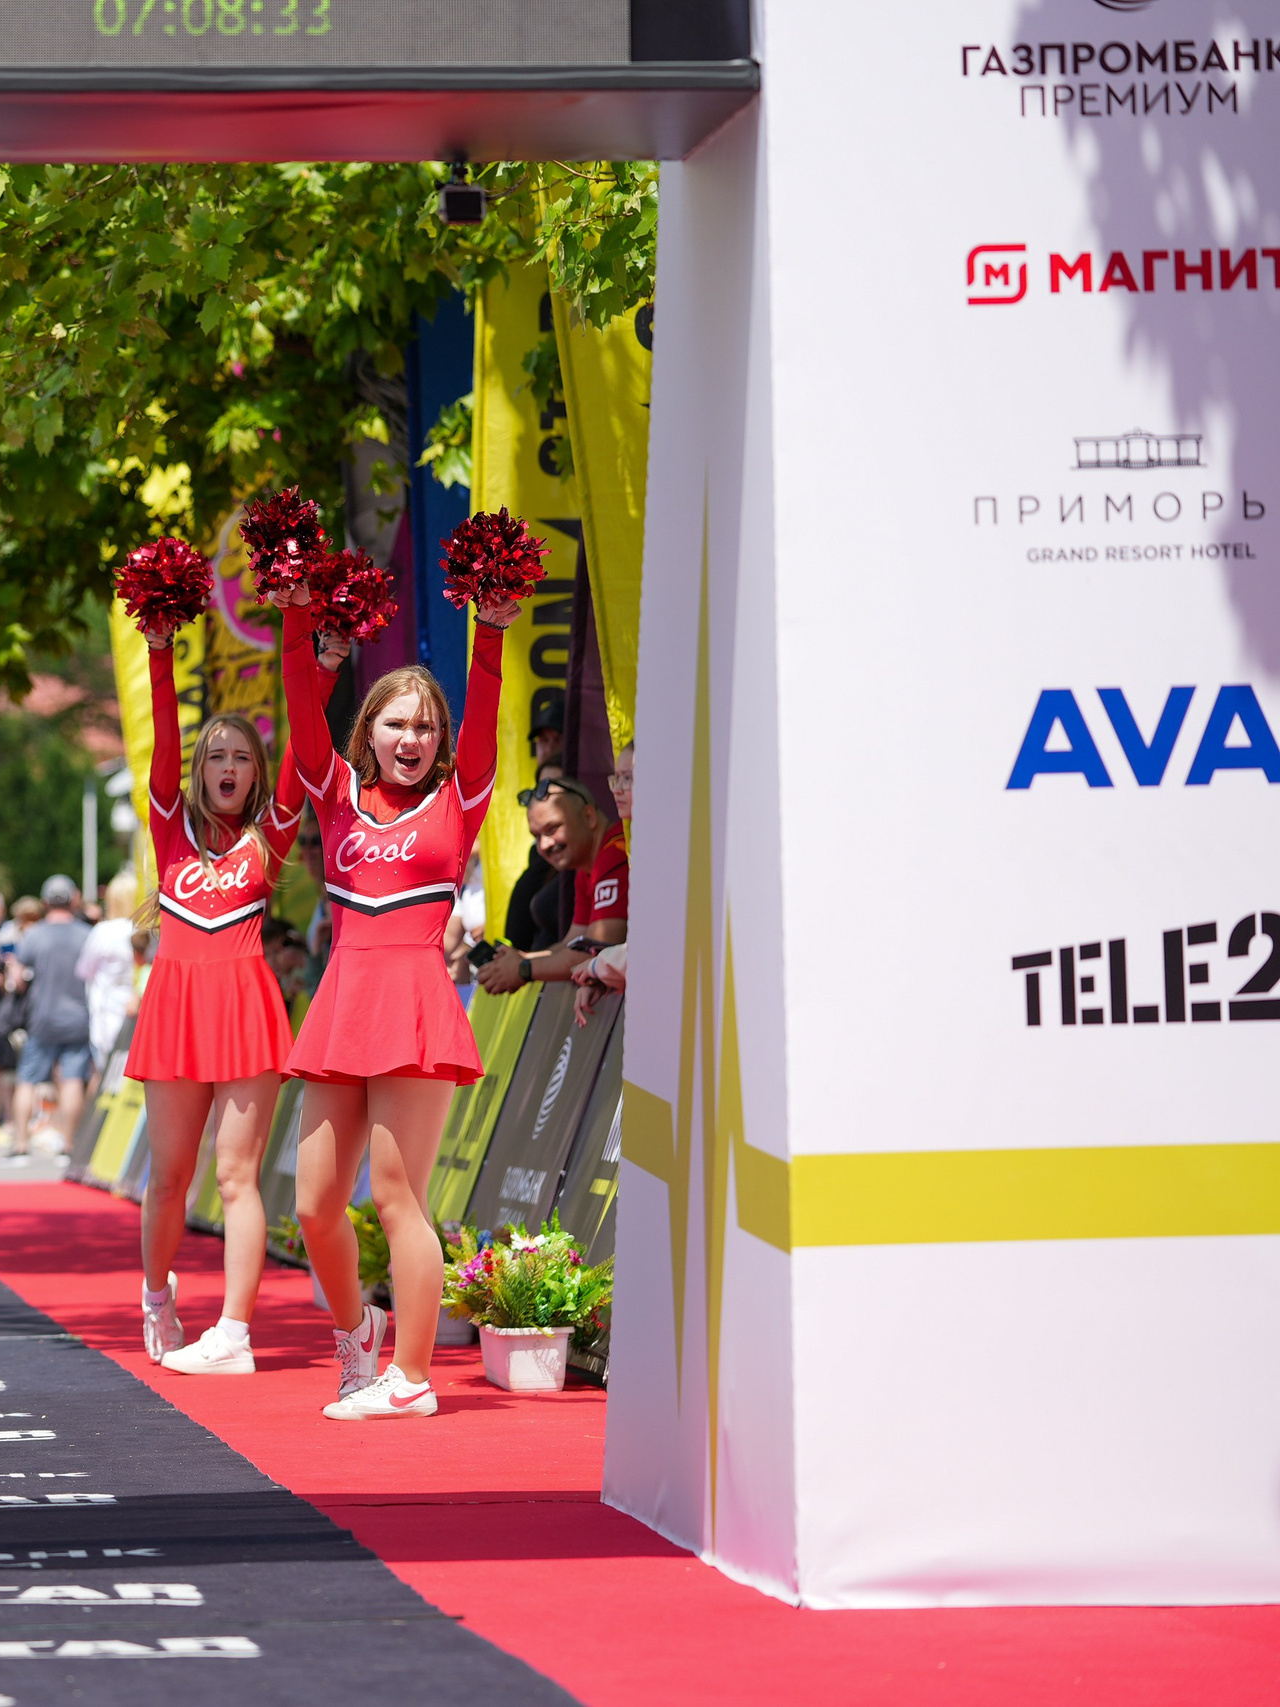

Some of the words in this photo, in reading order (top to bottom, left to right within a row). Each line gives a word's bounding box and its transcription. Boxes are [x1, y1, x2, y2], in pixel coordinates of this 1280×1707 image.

[1020, 81, 1238, 117] ПРЕМИУМ
[1049, 247, 1280, 293] МАГНИТ
[1026, 547, 1099, 563] GRAND
[1105, 545, 1185, 562] RESORT
[1191, 543, 1257, 560] HOTEL
[336, 831, 417, 872] Cool
[1011, 911, 1280, 1026] TELE2
